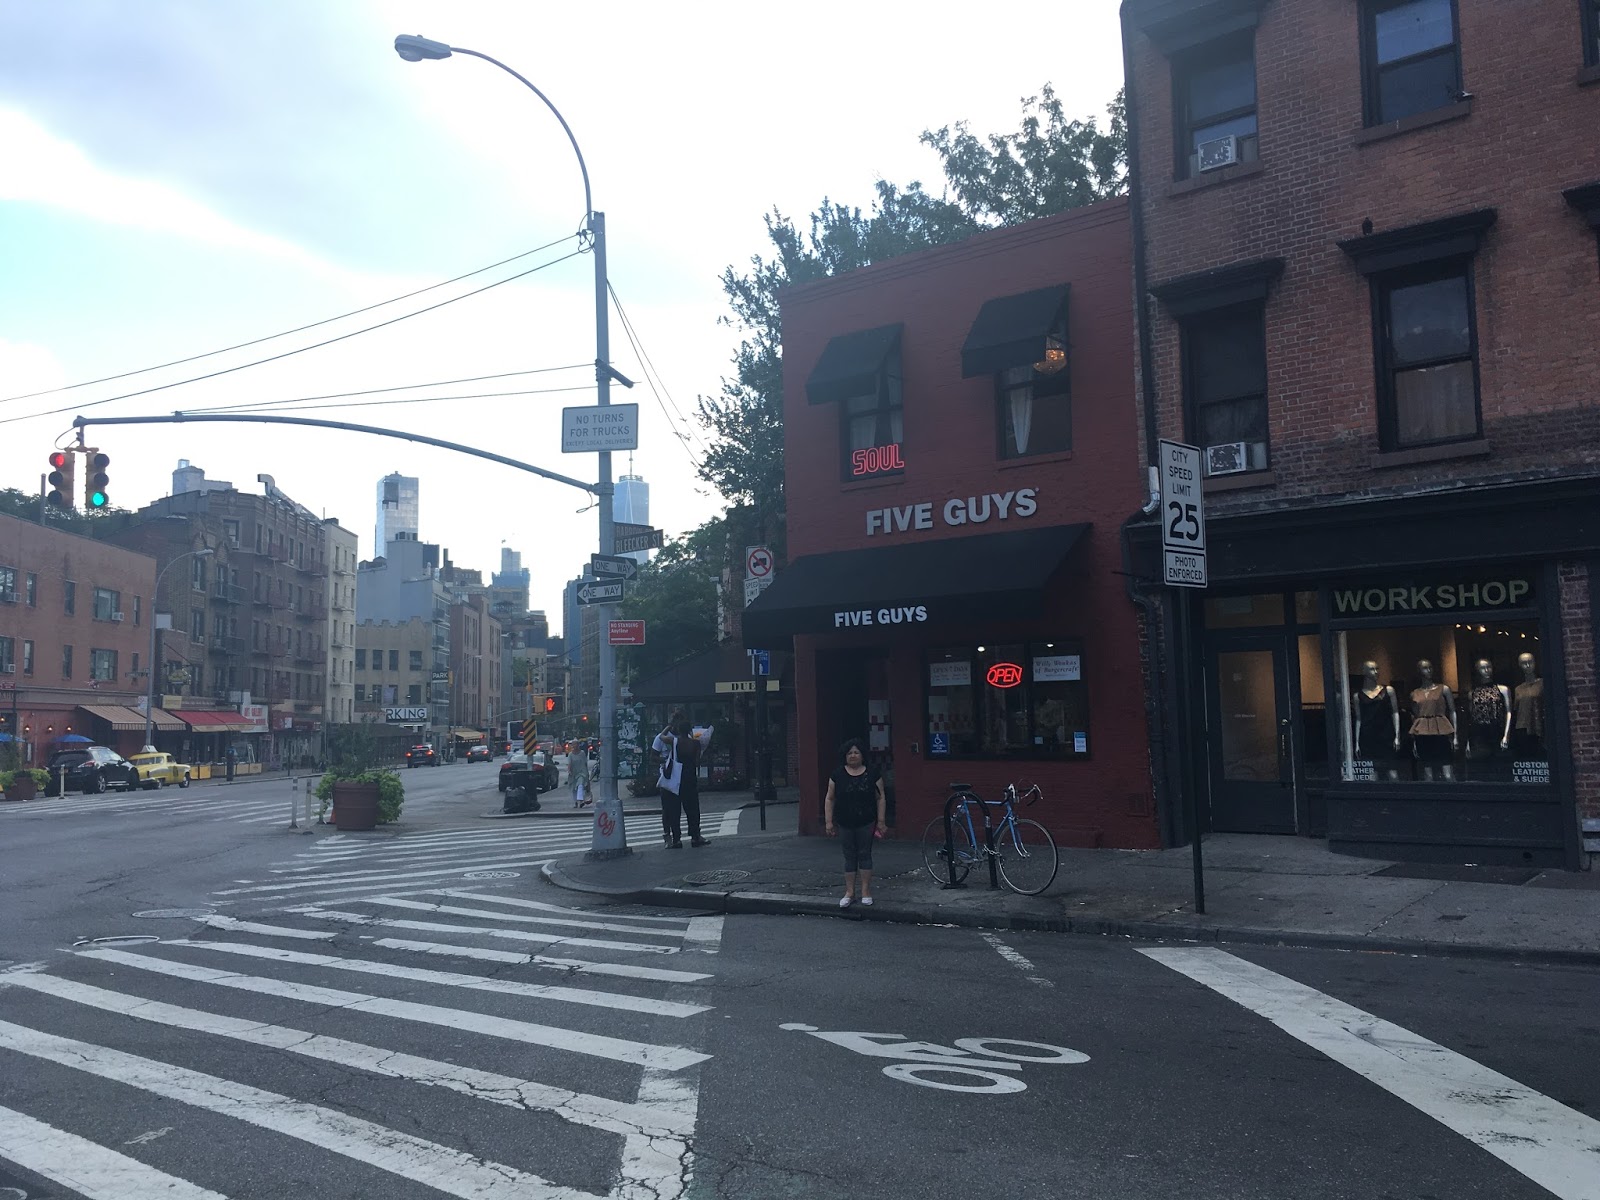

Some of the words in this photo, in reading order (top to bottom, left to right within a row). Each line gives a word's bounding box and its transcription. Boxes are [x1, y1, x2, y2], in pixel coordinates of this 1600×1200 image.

[576, 415, 589, 424] NO
[593, 413, 624, 423] TURNS
[570, 428, 588, 437] FOR
[592, 426, 630, 436] TRUCKS
[852, 443, 905, 476] SOUL
[1172, 450, 1188, 463] CITY
[1169, 466, 1193, 481] SPEED
[1172, 483, 1191, 497] LIMIT
[866, 502, 933, 536] FIVE
[943, 488, 1037, 526] GUYS
[1168, 501, 1200, 541] 25
[616, 535, 649, 553] BLEECKER
[652, 533, 660, 548] ST
[595, 562, 609, 571] ONE
[616, 563, 631, 573] WAY
[1175, 556, 1197, 568] PHOTO
[1168, 568, 1203, 580] ENFORCED
[582, 588, 597, 598] ONE
[604, 584, 619, 596] WAY
[1334, 579, 1529, 612] WORKSHOP
[834, 610, 873, 627] FIVE
[877, 605, 928, 624] GUYS
[987, 668, 1022, 683] OPEN
[386, 708, 426, 719] RKING
[1512, 768, 1550, 776] LEATHER
[1513, 761, 1549, 769] CUSTOM
